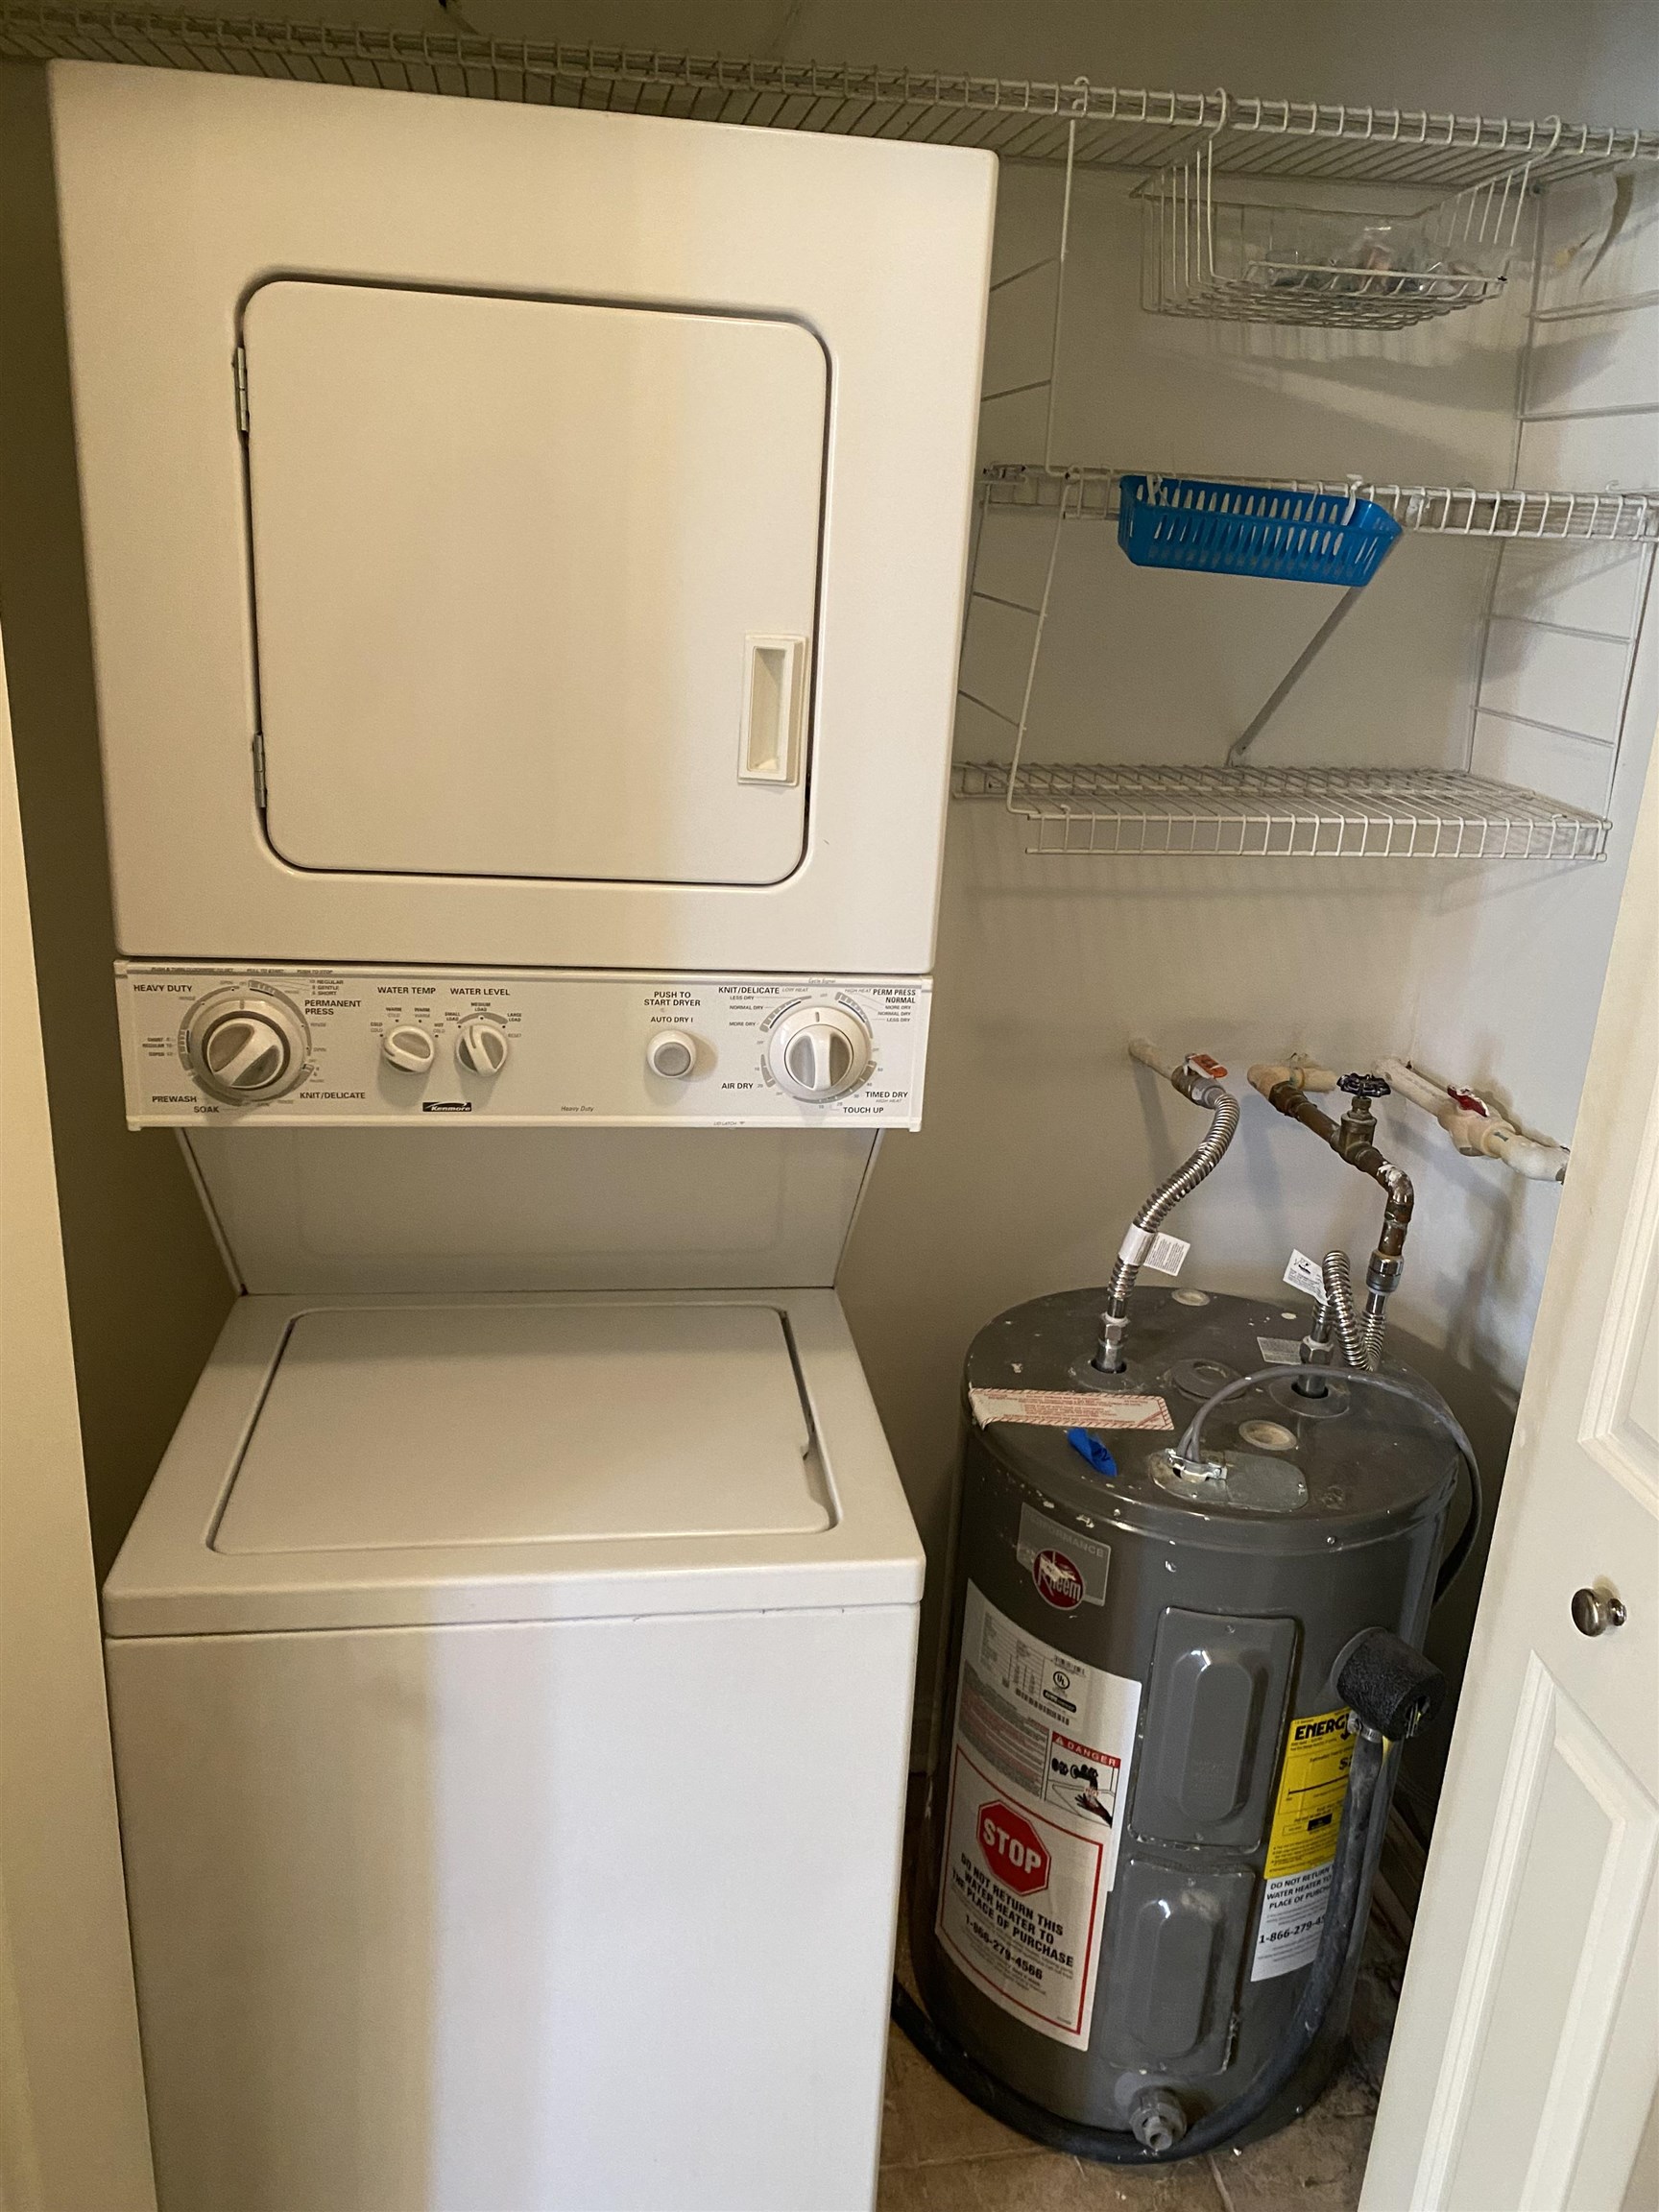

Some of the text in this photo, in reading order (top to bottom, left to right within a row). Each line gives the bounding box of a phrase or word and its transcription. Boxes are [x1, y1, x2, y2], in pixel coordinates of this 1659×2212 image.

[167, 984, 193, 993] DUTY
[718, 986, 780, 995] KNIT/DELICATE
[1067, 1741, 1117, 1767] DANGER
[982, 1817, 1042, 1874] STOP
[1266, 1888, 1293, 1900] WATER
[1294, 1879, 1322, 1894] HEATER
[1270, 1882, 1284, 1890] DO
[1284, 1878, 1301, 1887] NOT
[1302, 1867, 1331, 1882] RETURN
[961, 1852, 1064, 1936] DO NOT RETURN THIS
[1268, 1898, 1291, 1910] PLACE
[1293, 1893, 1304, 1903] OF
[952, 1866, 965, 1889] THE
[967, 1887, 995, 1919] PLACE
[997, 1914, 1010, 1930] OF
[1012, 1926, 1074, 1967] PURCHASE
[965, 1870, 1054, 1945] WATER HEATER TO
